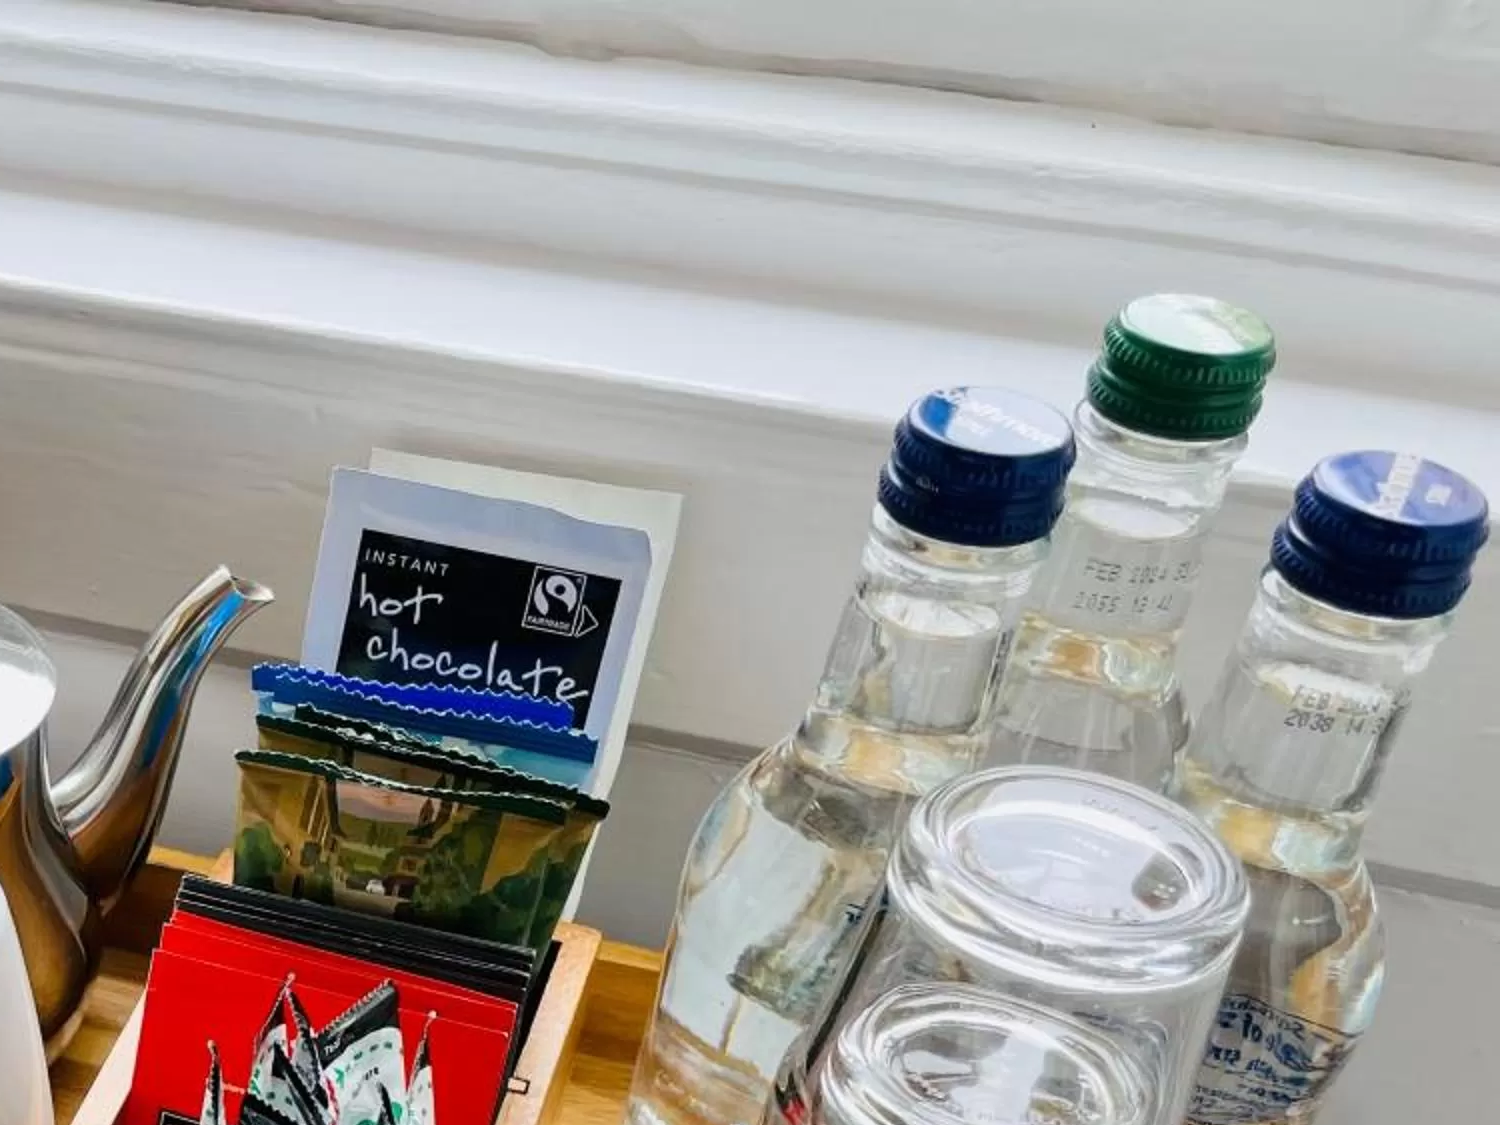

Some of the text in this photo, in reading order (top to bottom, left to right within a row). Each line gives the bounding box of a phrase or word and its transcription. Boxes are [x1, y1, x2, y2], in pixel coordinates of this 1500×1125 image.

[365, 548, 449, 577] INSTANT
[359, 572, 443, 624] hot
[366, 627, 590, 701] chocolate
